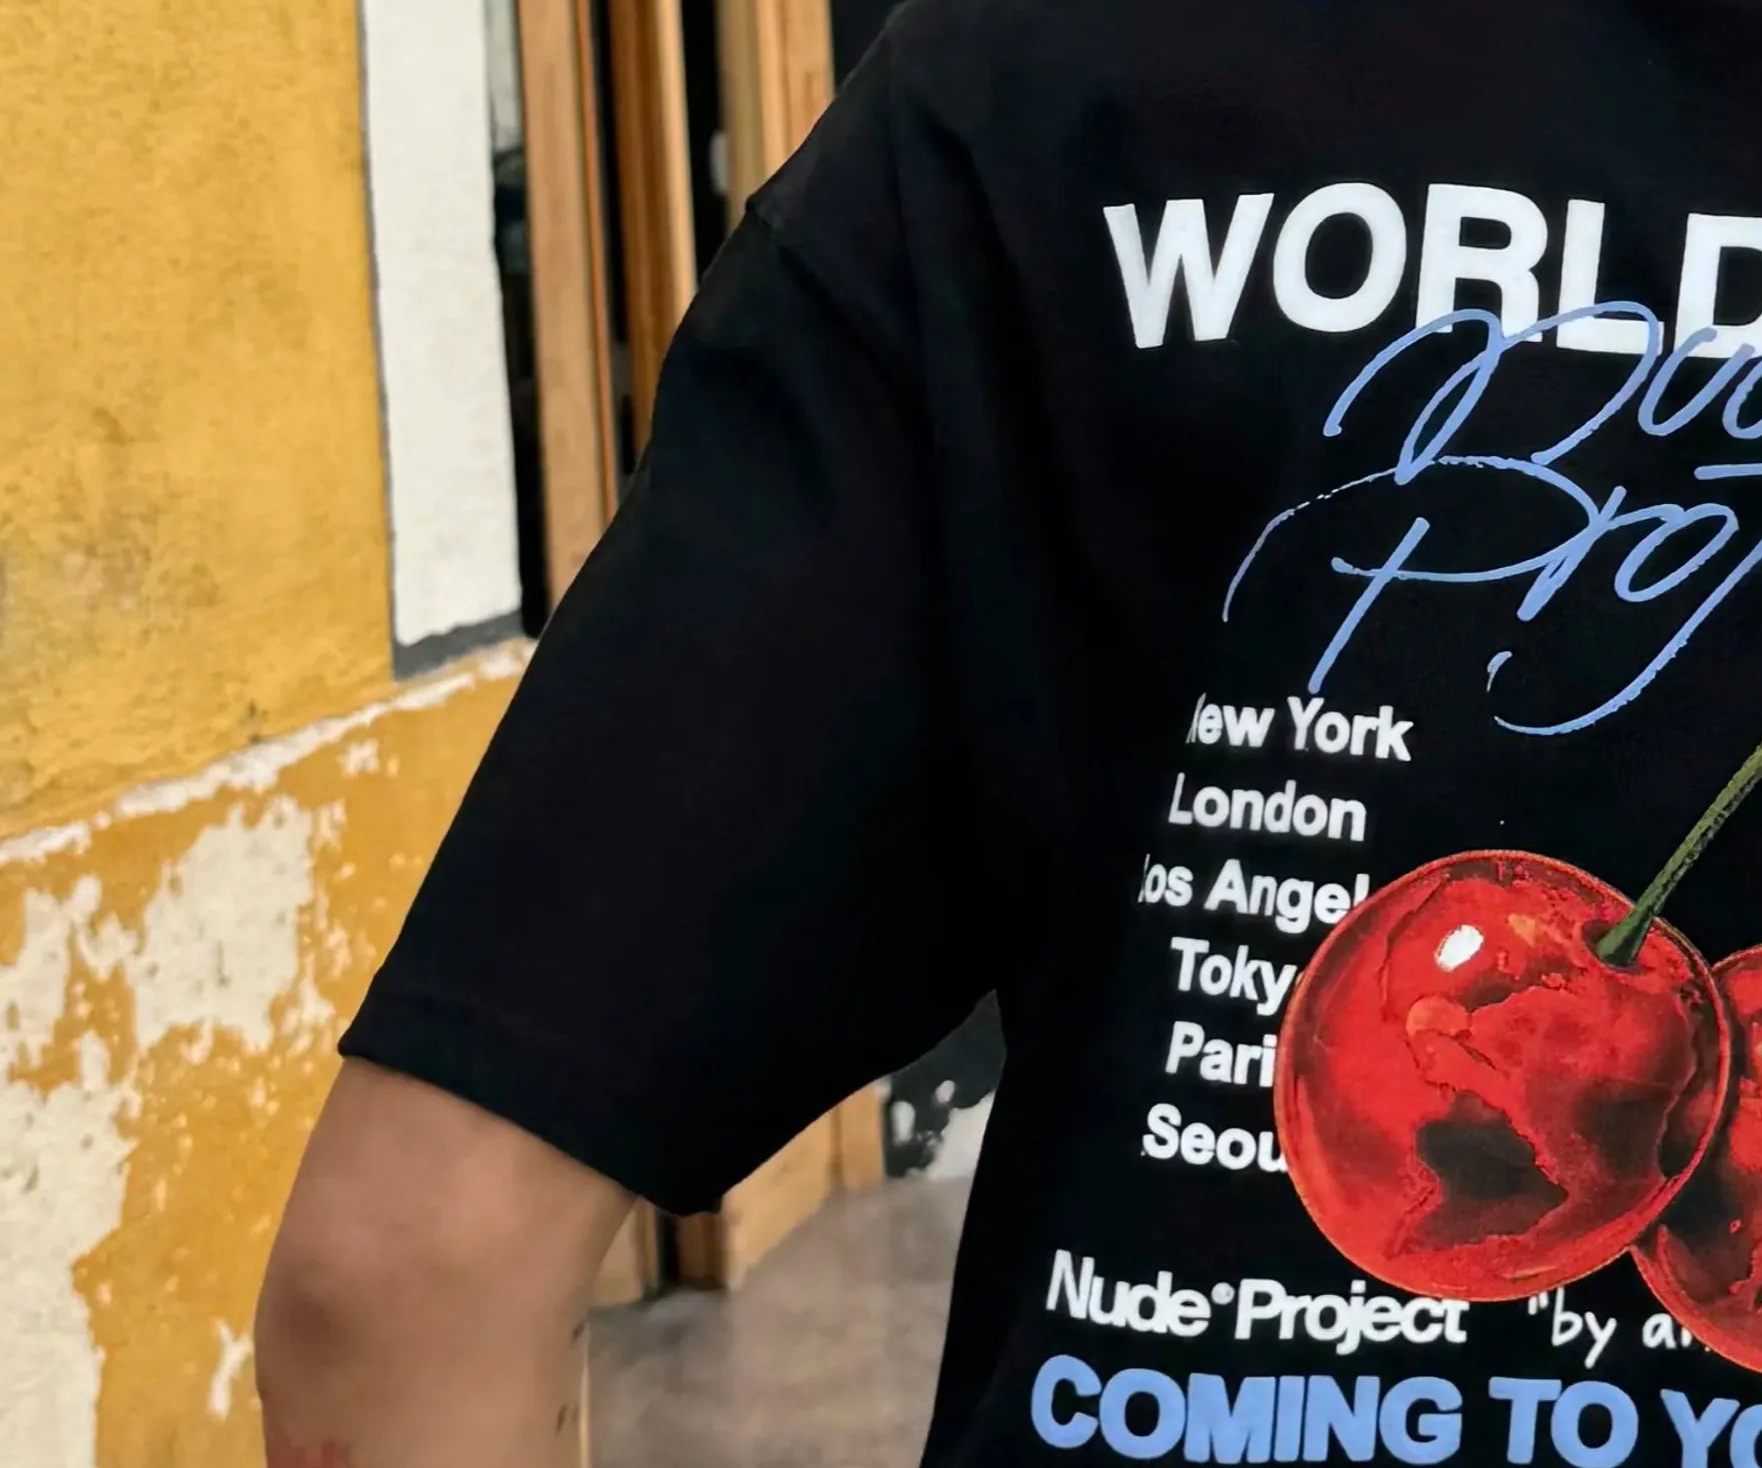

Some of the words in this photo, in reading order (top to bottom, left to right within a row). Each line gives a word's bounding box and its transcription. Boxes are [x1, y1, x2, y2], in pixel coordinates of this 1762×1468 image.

[1287, 696, 1414, 762] York
[1168, 772, 1367, 842] London
[1203, 858, 1370, 934] Angel
[1170, 936, 1303, 1017] Toky
[1164, 1020, 1278, 1088] Pari
[1141, 1103, 1290, 1174] Seou
[1031, 1354, 1463, 1465] COMING
